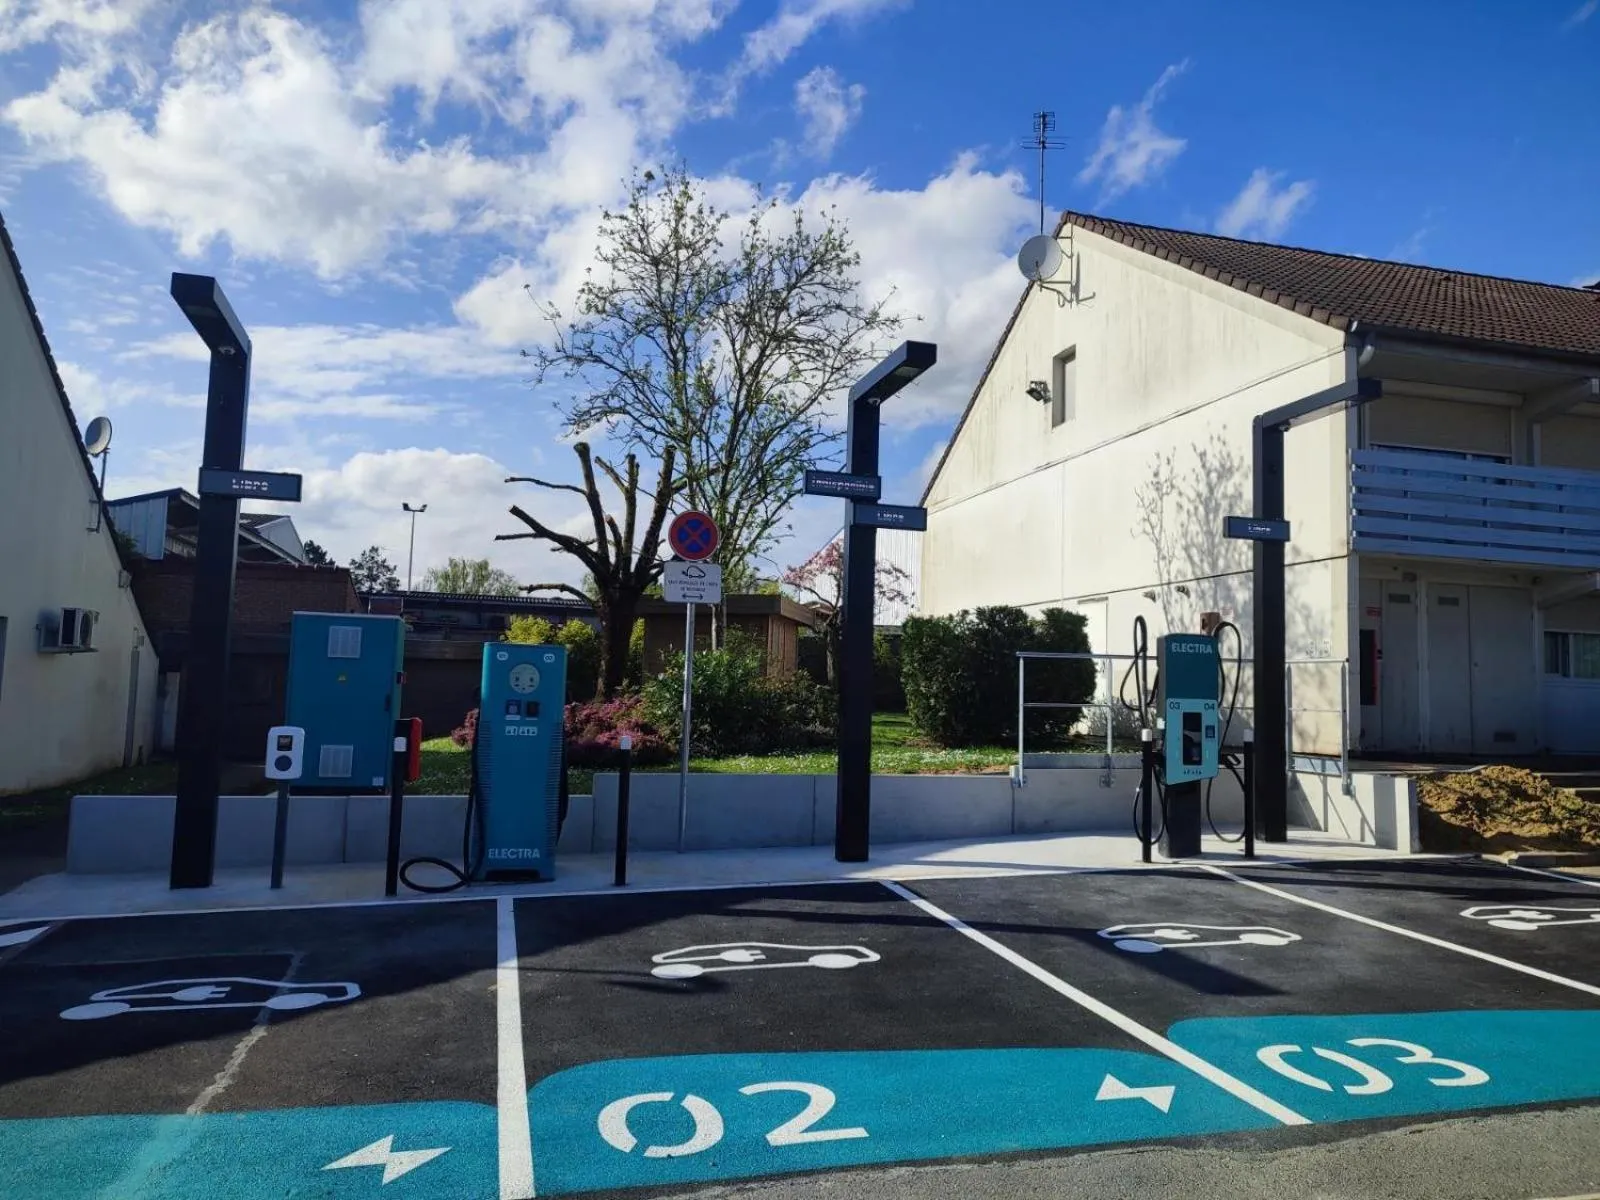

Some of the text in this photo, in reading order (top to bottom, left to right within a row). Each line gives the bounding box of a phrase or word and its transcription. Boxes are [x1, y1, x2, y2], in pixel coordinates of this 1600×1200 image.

[1171, 642, 1212, 654] ELECTRA
[1169, 701, 1181, 710] 03
[1204, 703, 1215, 712] 04
[488, 847, 541, 859] ELECTRA
[1257, 1038, 1490, 1096] 03
[597, 1081, 870, 1158] 02
